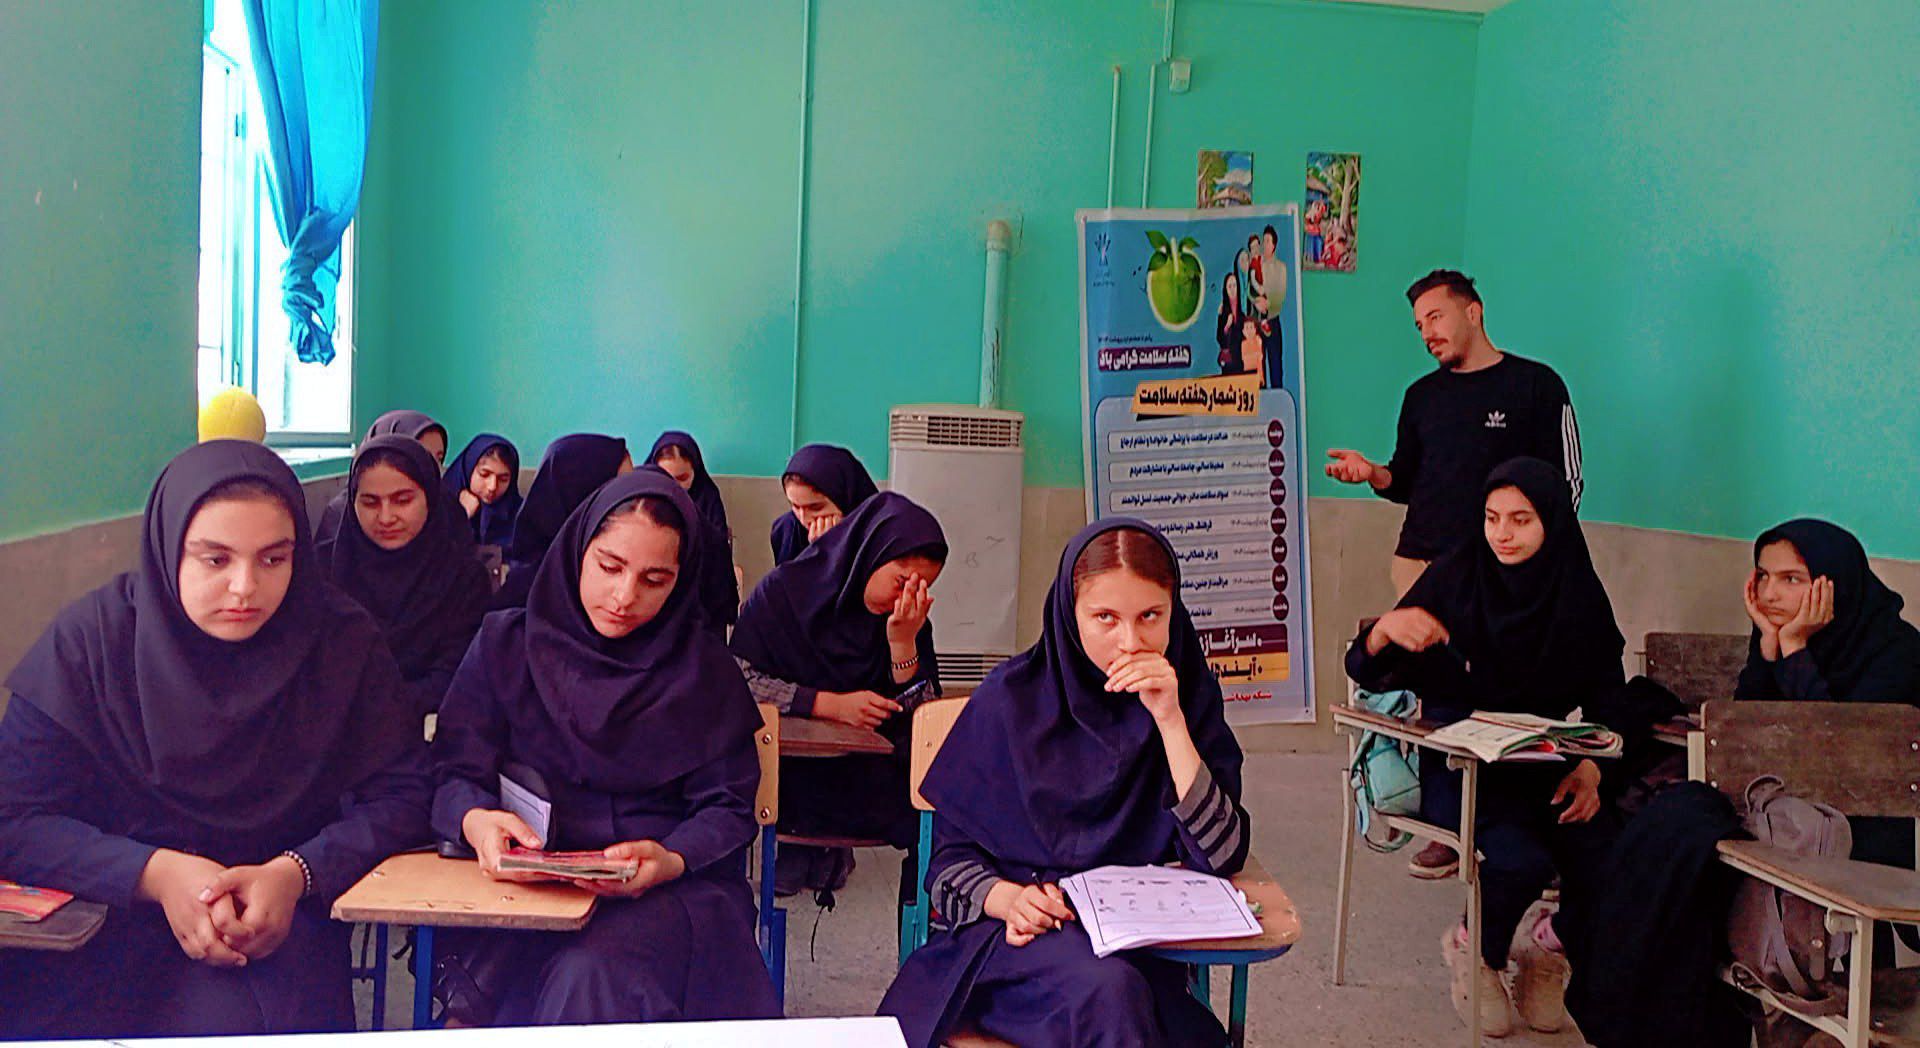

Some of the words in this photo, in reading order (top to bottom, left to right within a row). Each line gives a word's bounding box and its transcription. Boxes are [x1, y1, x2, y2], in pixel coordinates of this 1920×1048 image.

[1100, 351, 1112, 370] باد
[1113, 349, 1138, 370] گرامی
[1139, 349, 1167, 365] سلامت
[1168, 346, 1189, 364] هفته
[1139, 385, 1179, 406] سلامت
[1180, 383, 1207, 406] هفته
